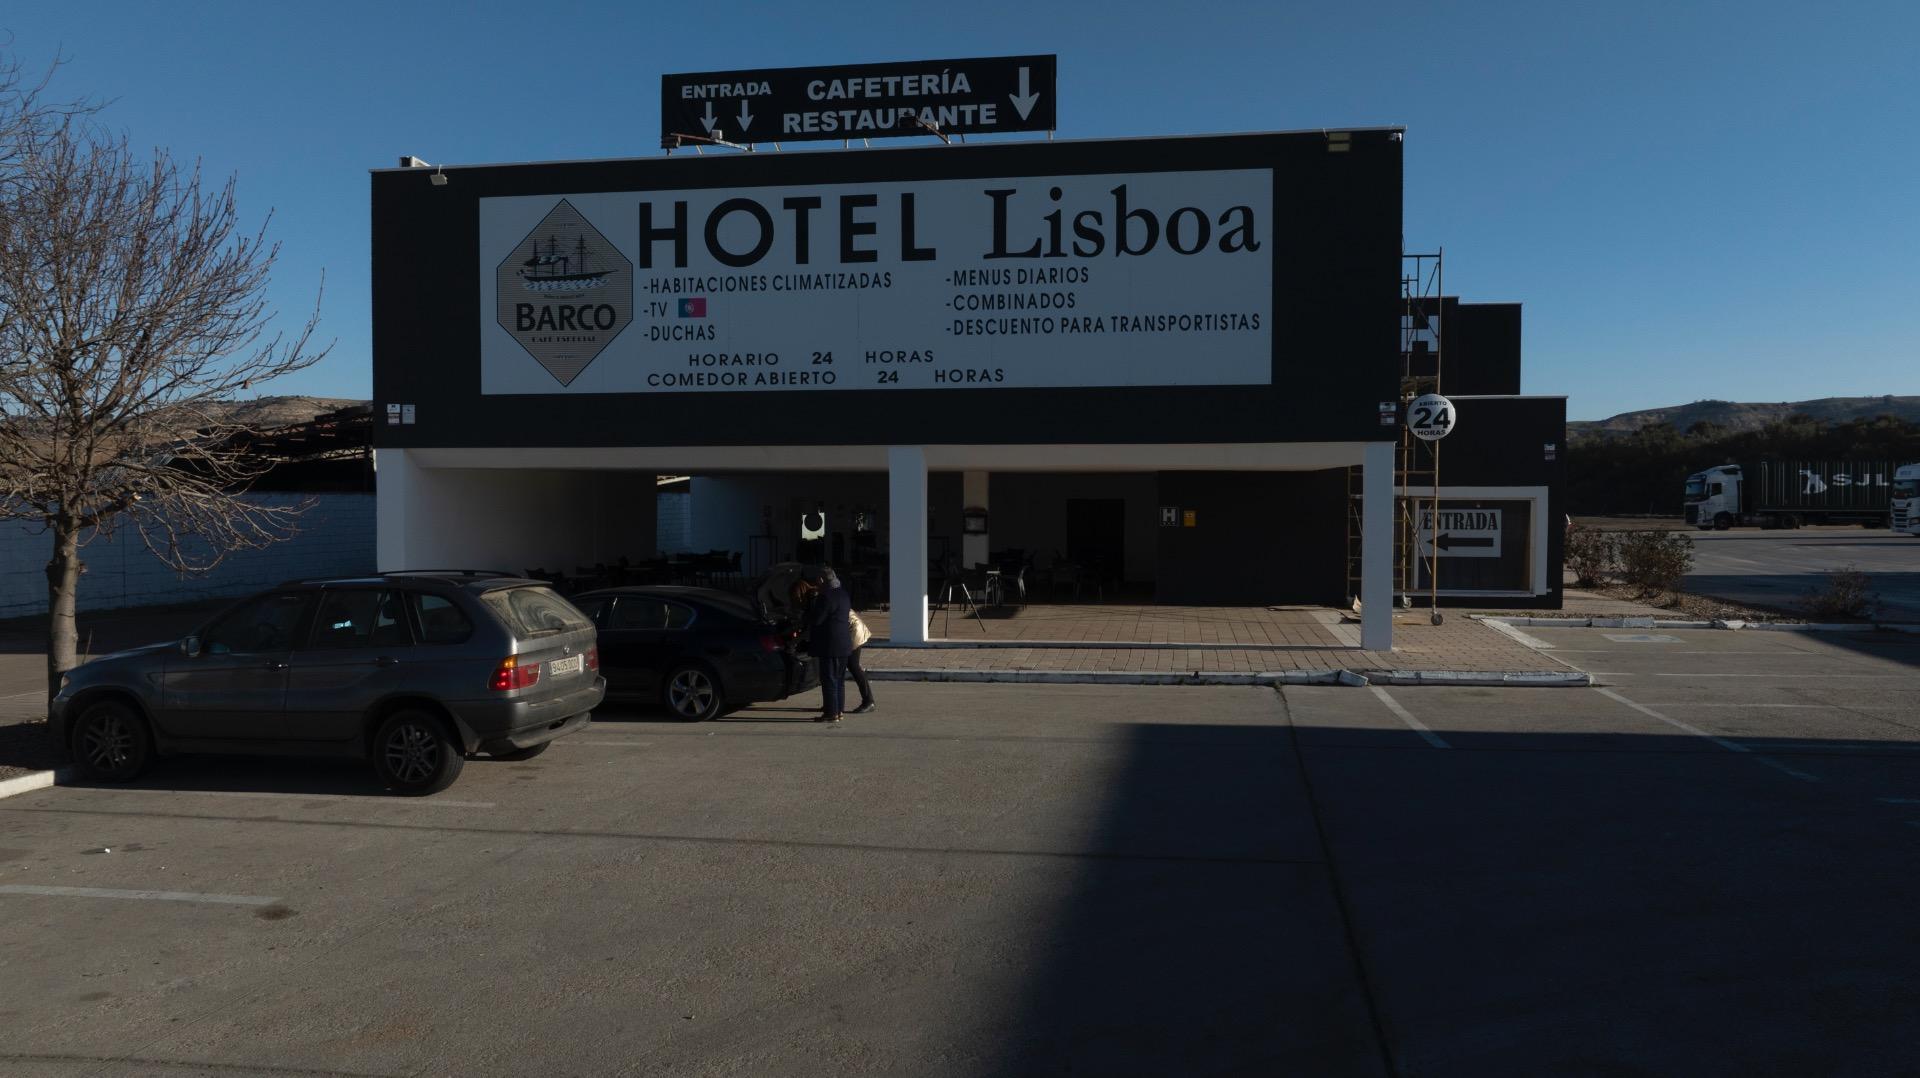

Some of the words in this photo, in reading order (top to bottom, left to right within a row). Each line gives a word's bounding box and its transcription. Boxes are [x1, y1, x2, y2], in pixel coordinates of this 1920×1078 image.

[681, 81, 772, 99] ENTRADA
[807, 68, 972, 100] CAFETERÍA
[783, 103, 997, 134] RESTAURANTE
[639, 192, 937, 268] HOTEL
[983, 183, 1261, 259] Lisboa
[772, 271, 892, 291] CLIMATIZADAS
[1017, 266, 1089, 285] DIARIOS
[516, 302, 617, 332] BARCO
[1060, 316, 1105, 334] PARA
[1110, 312, 1260, 332] TRANSPORTISTAS
[688, 352, 779, 367] HORARIO
[811, 351, 833, 365] 24
[865, 349, 934, 364] HORAS
[647, 372, 748, 387] COMEDOR
[754, 370, 837, 386] ABIERTO
[877, 370, 899, 384] 24
[934, 368, 1004, 383] HORAS
[1413, 407, 1451, 429] 24
